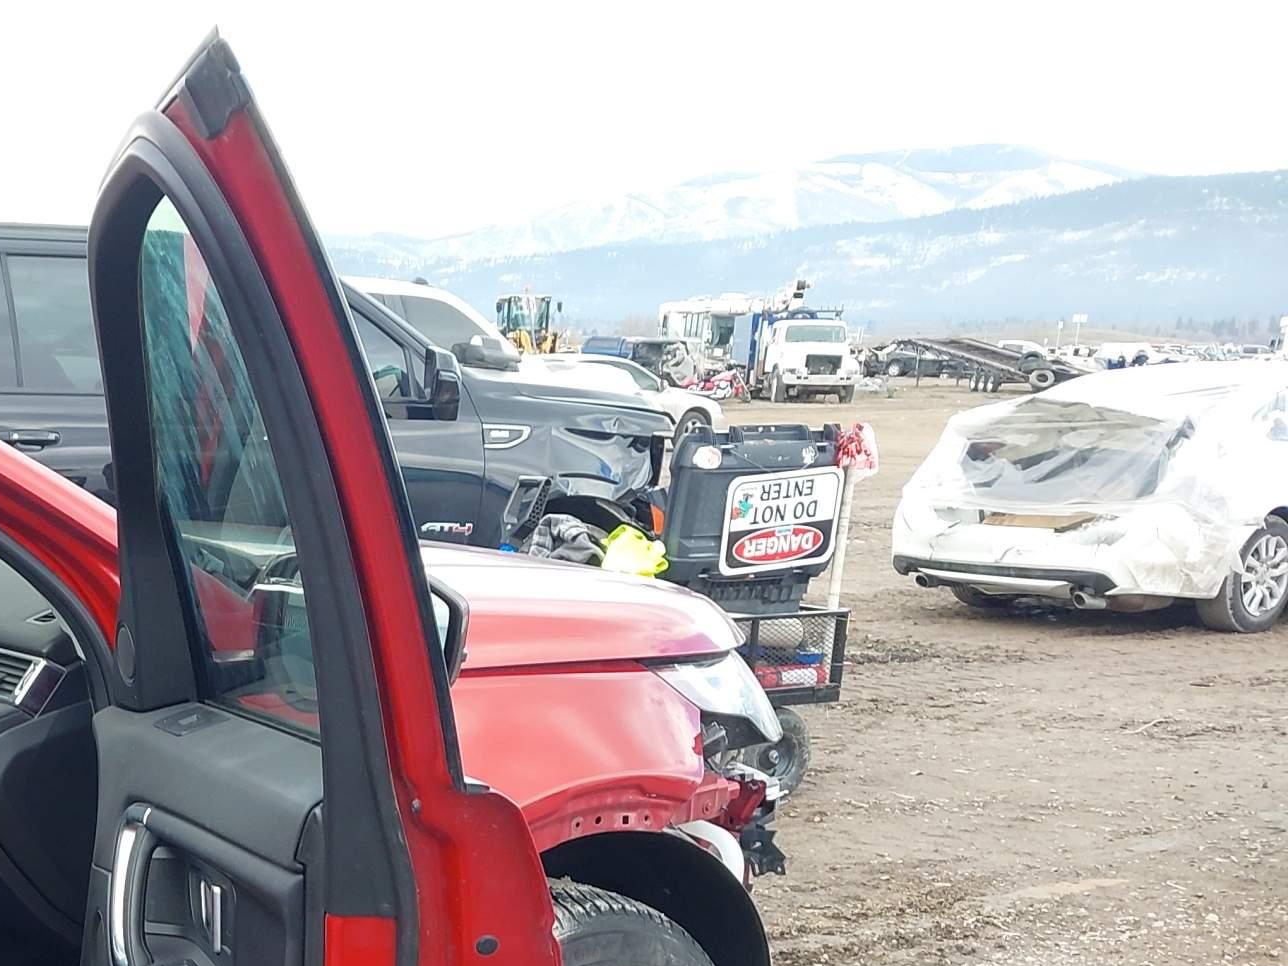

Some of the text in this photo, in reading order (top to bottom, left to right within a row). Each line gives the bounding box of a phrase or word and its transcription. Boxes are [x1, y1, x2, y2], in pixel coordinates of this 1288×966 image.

[760, 479, 815, 501] ENTER
[749, 500, 818, 525] DO NOT
[421, 523, 473, 536] AT4
[743, 531, 815, 558] DANGER
